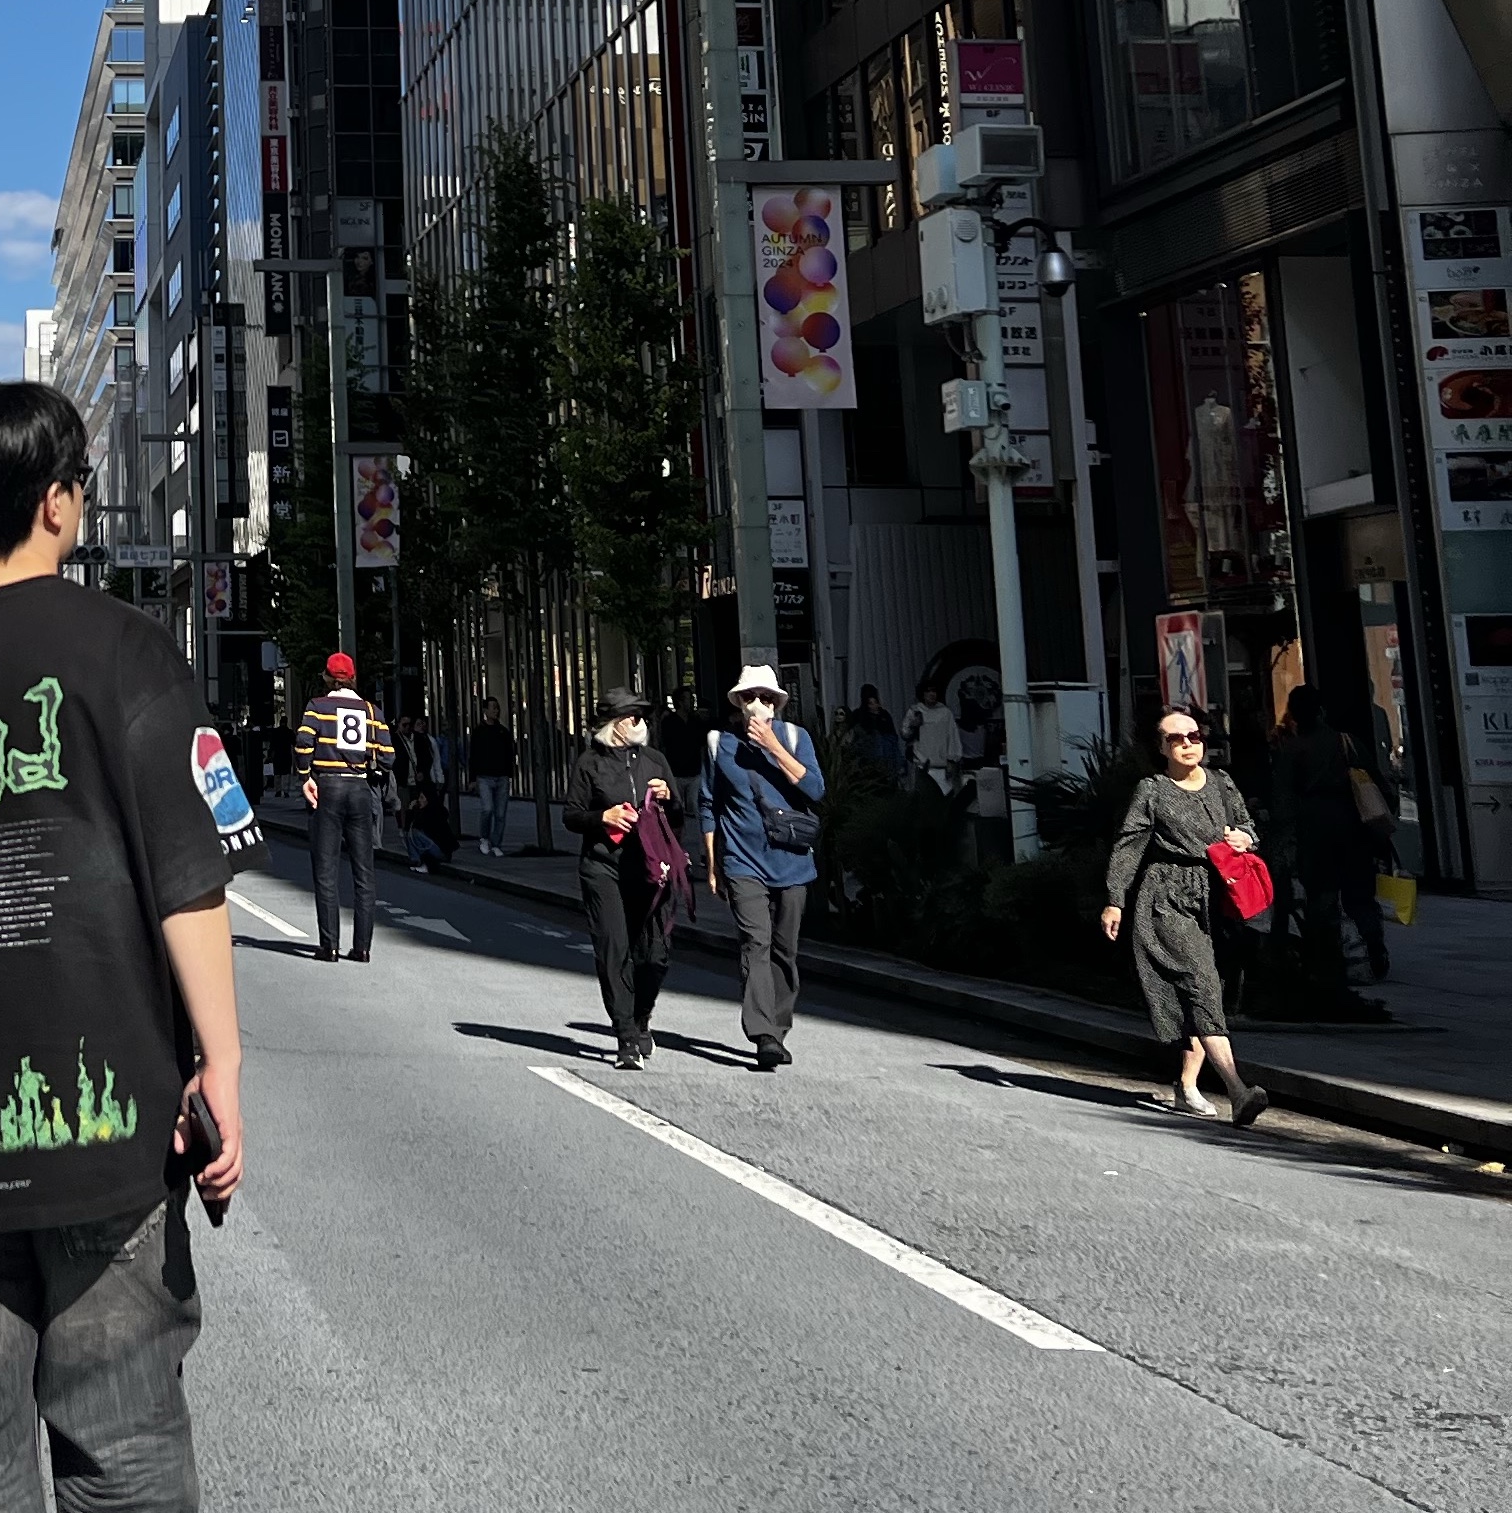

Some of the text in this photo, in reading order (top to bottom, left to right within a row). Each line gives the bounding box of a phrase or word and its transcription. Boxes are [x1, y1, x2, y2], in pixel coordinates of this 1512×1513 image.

[761, 233, 823, 244] AUTUMN
[761, 246, 805, 256] GINZA
[269, 213, 285, 302] MONTANC
[763, 258, 794, 268] 2024
[342, 714, 362, 745] 8
